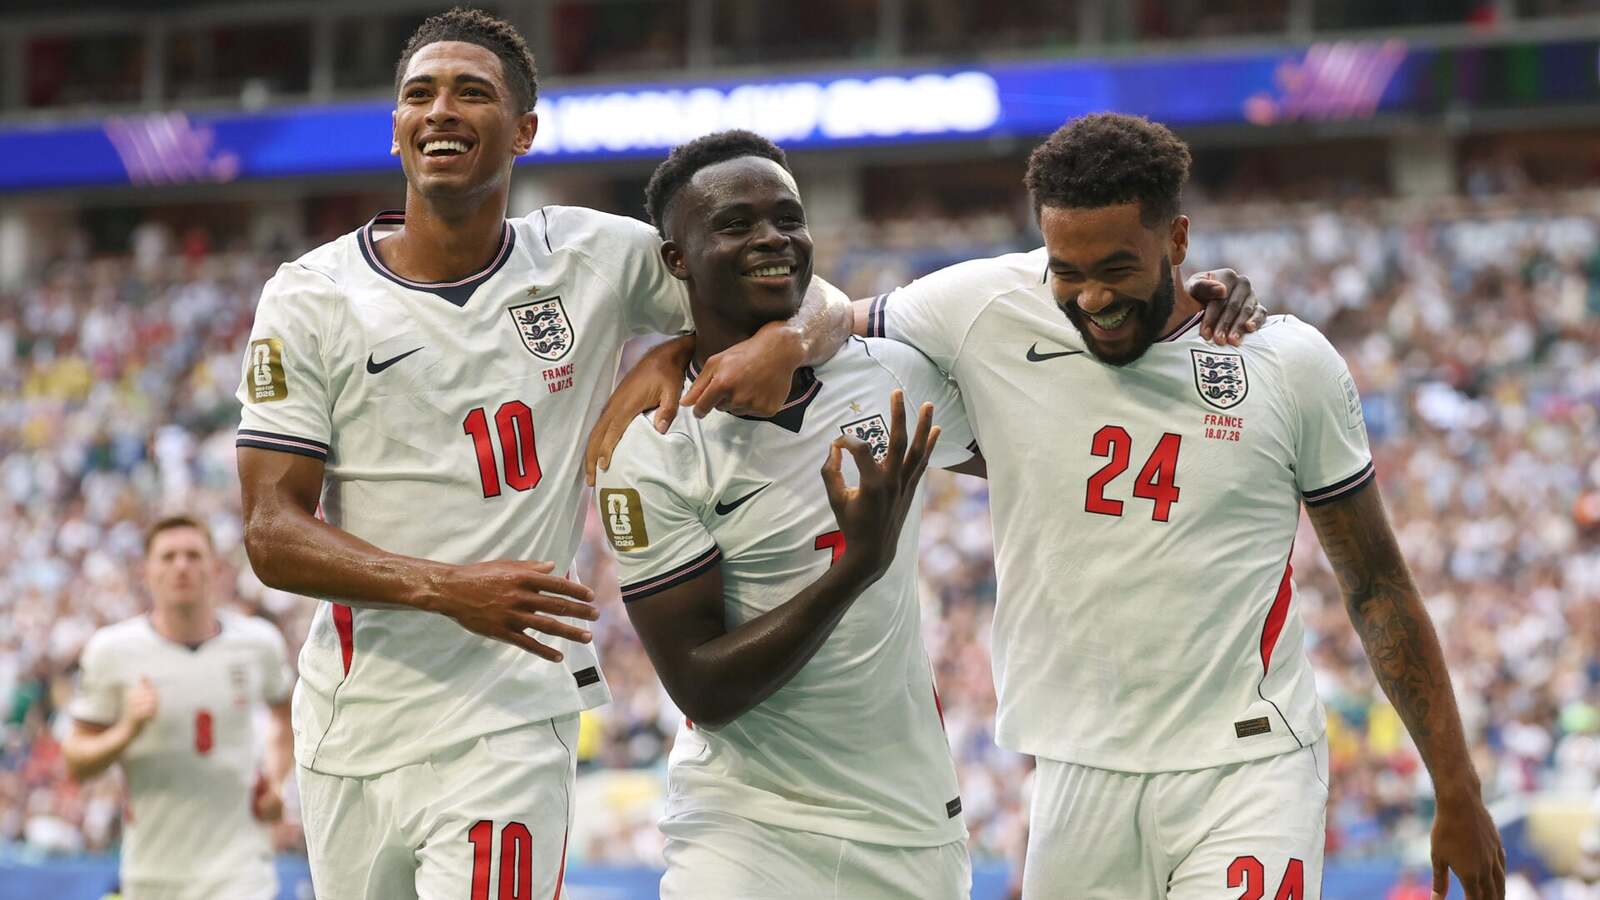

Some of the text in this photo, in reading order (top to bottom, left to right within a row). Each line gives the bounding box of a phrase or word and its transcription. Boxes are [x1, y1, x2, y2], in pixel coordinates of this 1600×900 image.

[542, 363, 574, 381] FRANCE
[1204, 414, 1243, 428] FRANCE
[1205, 428, 1240, 441] 18.07.26
[463, 400, 542, 498] 10
[1085, 425, 1181, 522] 24
[468, 820, 532, 900] 10
